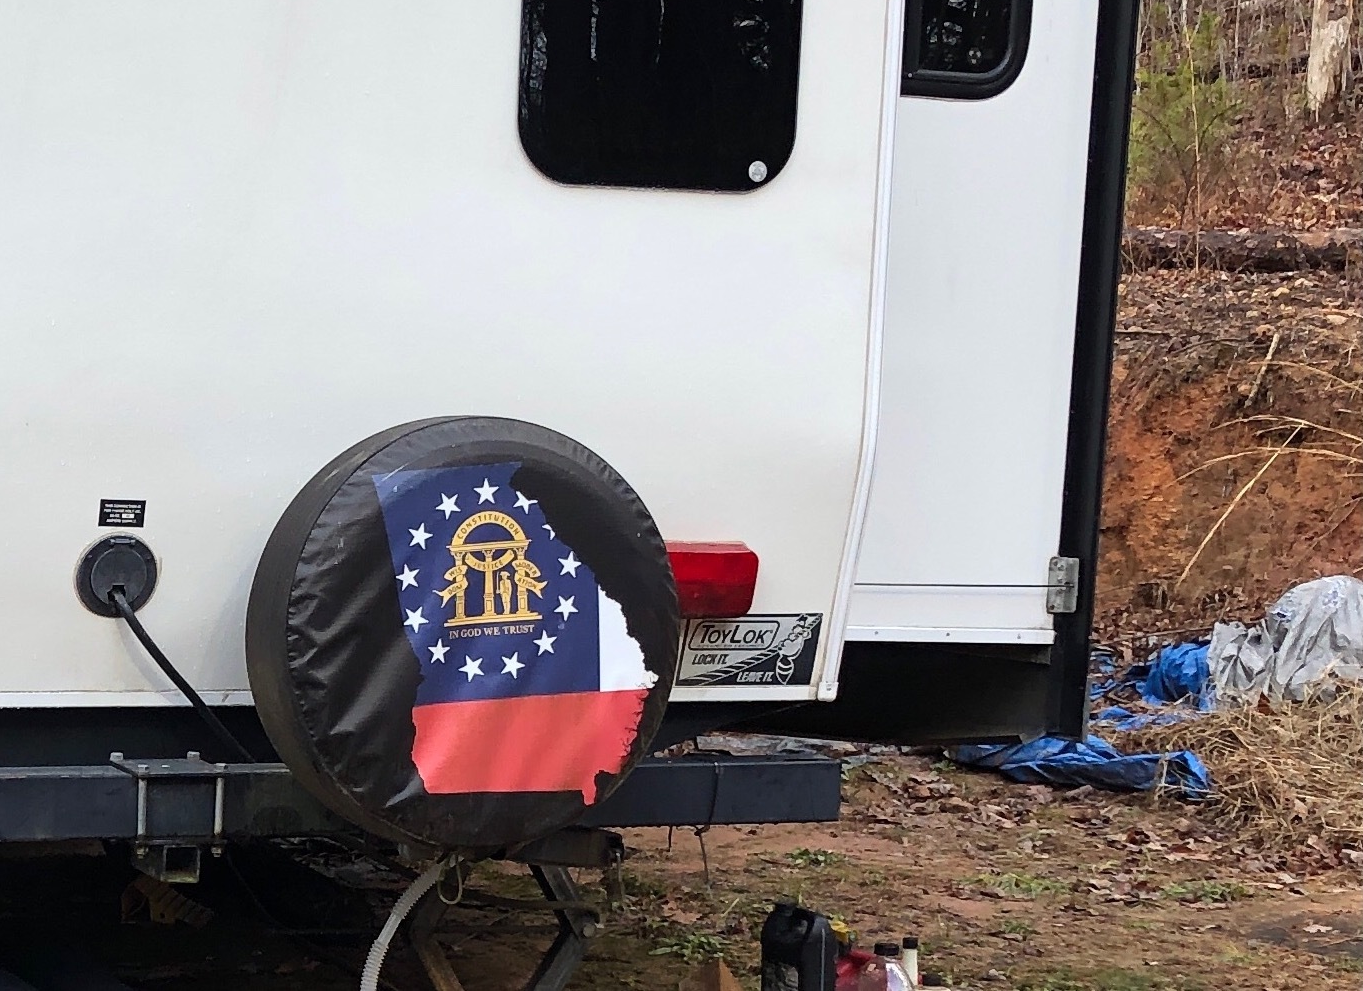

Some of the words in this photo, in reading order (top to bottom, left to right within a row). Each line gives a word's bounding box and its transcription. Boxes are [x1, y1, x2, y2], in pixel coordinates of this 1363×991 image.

[456, 513, 520, 540] CONSTITUTION
[473, 559, 503, 570] JUSTICE
[449, 630, 459, 639] IN
[460, 628, 482, 638] GOD
[484, 627, 501, 636] WE
[502, 624, 535, 635] TRUST
